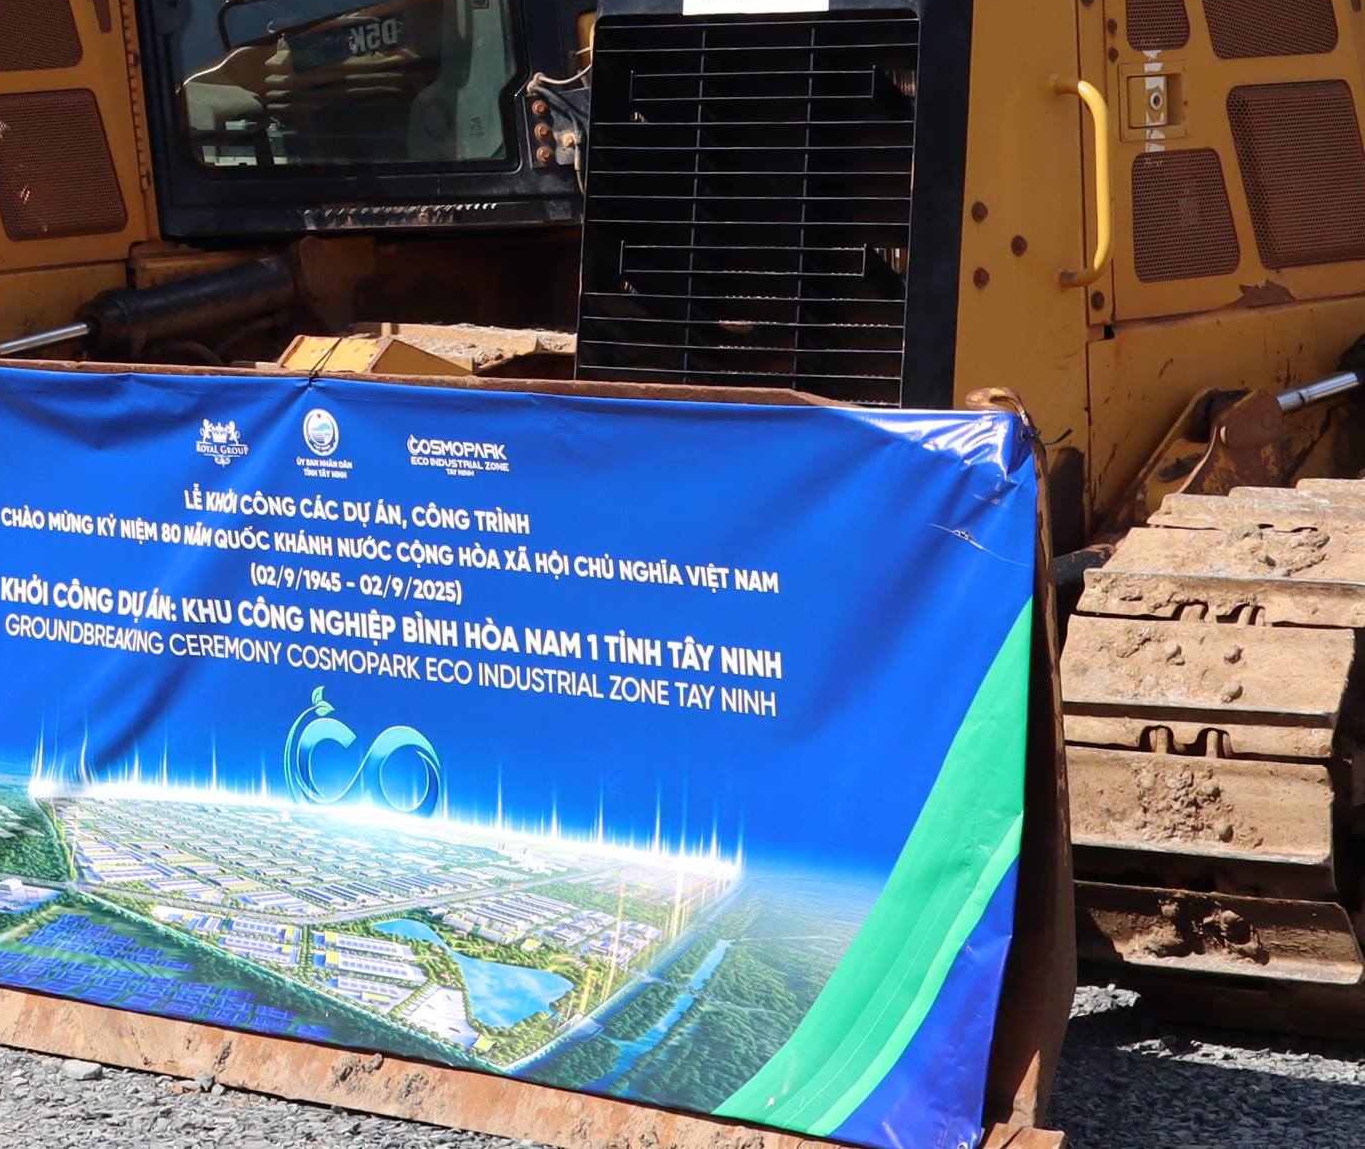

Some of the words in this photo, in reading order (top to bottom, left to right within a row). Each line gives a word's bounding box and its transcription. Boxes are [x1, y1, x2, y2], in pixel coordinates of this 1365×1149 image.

[196, 442, 219, 454] ROYAL
[221, 444, 249, 456] GROUP
[407, 434, 507, 460] COSMOPARK
[411, 456, 429, 466] ECO
[429, 458, 483, 470] INDUSTRIAL
[485, 461, 509, 472] ZONE
[185, 484, 203, 510] LỄ
[206, 489, 237, 513] KHỞI
[240, 491, 296, 516] CÔNG
[300, 495, 339, 520] CÁC
[343, 502, 371, 527] DỰ
[375, 499, 407, 528] ÁN,
[412, 502, 470, 530] CÔNG
[474, 507, 529, 534] TRÌNH
[1, 505, 45, 529] CHÀO
[49, 510, 93, 534] MỪNG
[97, 514, 116, 536] KỶ
[121, 518, 157, 544] NIỆM
[162, 523, 181, 543] 80
[184, 522, 212, 546] NĂM
[215, 526, 269, 550] QUỐC
[274, 530, 333, 556] KHÁNH
[337, 536, 391, 560] NƯỚC
[397, 540, 453, 568] CỘNG
[459, 543, 500, 569] HÒA
[505, 546, 531, 572] XÃ
[535, 550, 569, 579] HỘI
[574, 554, 614, 579] CHỦ
[619, 560, 683, 584] NGHĨA
[685, 564, 729, 588] VIỆT
[735, 569, 778, 593] NAM
[251, 563, 341, 592] (02/9/1945
[360, 575, 461, 604] 02/9/2025)
[1, 574, 48, 605] KHỞI
[53, 578, 113, 613] CÔNG
[118, 590, 145, 622] DỰ
[147, 588, 177, 621] ÁN:
[182, 598, 232, 623] KHU
[238, 596, 303, 631] CÔNG
[310, 608, 395, 639] NGHIỆP
[403, 612, 457, 646] BÌNH
[465, 618, 518, 652] HÒA
[525, 628, 581, 658] NAM
[587, 634, 597, 660] 1
[604, 630, 661, 666] TỈNH
[667, 636, 713, 671] TÂY
[721, 647, 781, 678] NINH
[5, 614, 163, 654] GROUNDBREAKING
[169, 634, 281, 664] CEREMONY
[287, 644, 419, 679] COSMOPARK
[426, 658, 472, 684] ECO
[479, 663, 603, 698] INDUSTRIAL
[610, 676, 669, 705] ZONE
[680, 682, 713, 709] TAY
[722, 688, 775, 716] NINH
